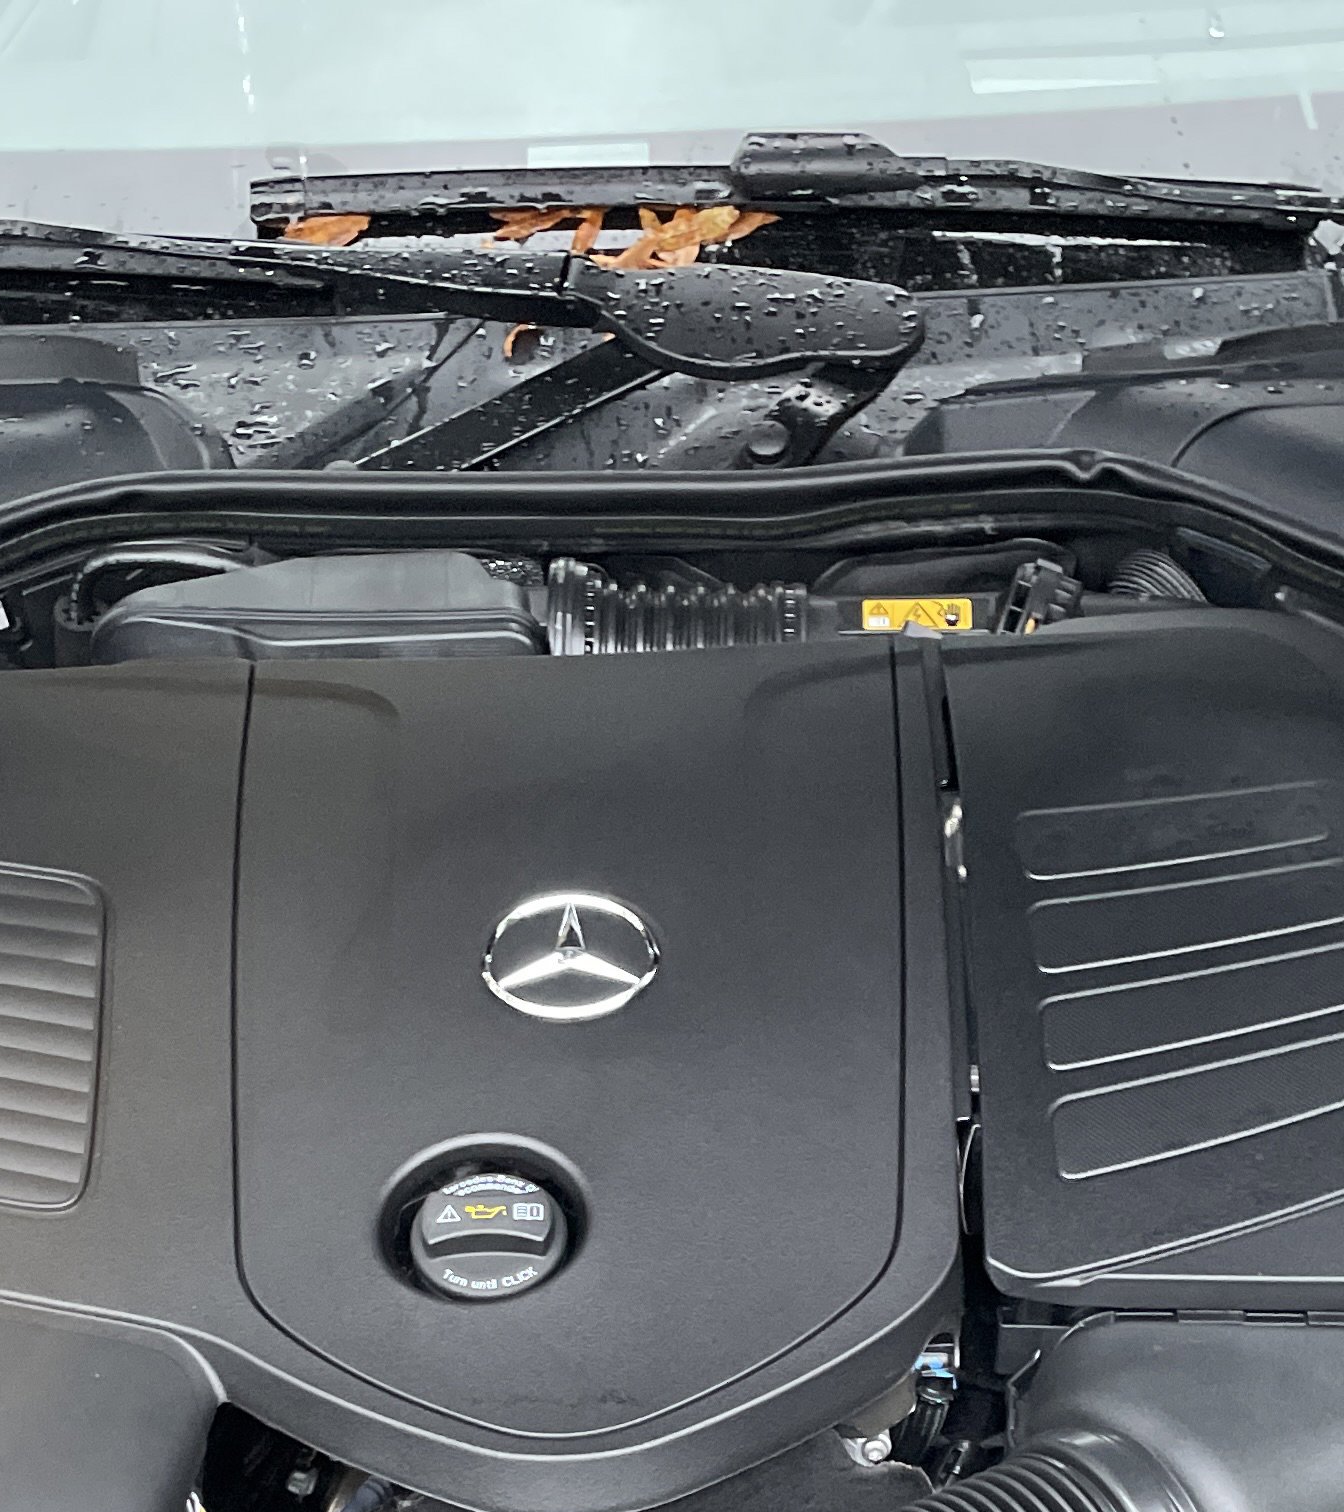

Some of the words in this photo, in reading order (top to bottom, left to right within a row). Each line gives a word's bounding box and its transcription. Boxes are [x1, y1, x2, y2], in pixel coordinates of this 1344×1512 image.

[442, 1268, 468, 1287] Turn
[471, 1278, 498, 1290] until
[501, 1266, 538, 1287] CLICK
